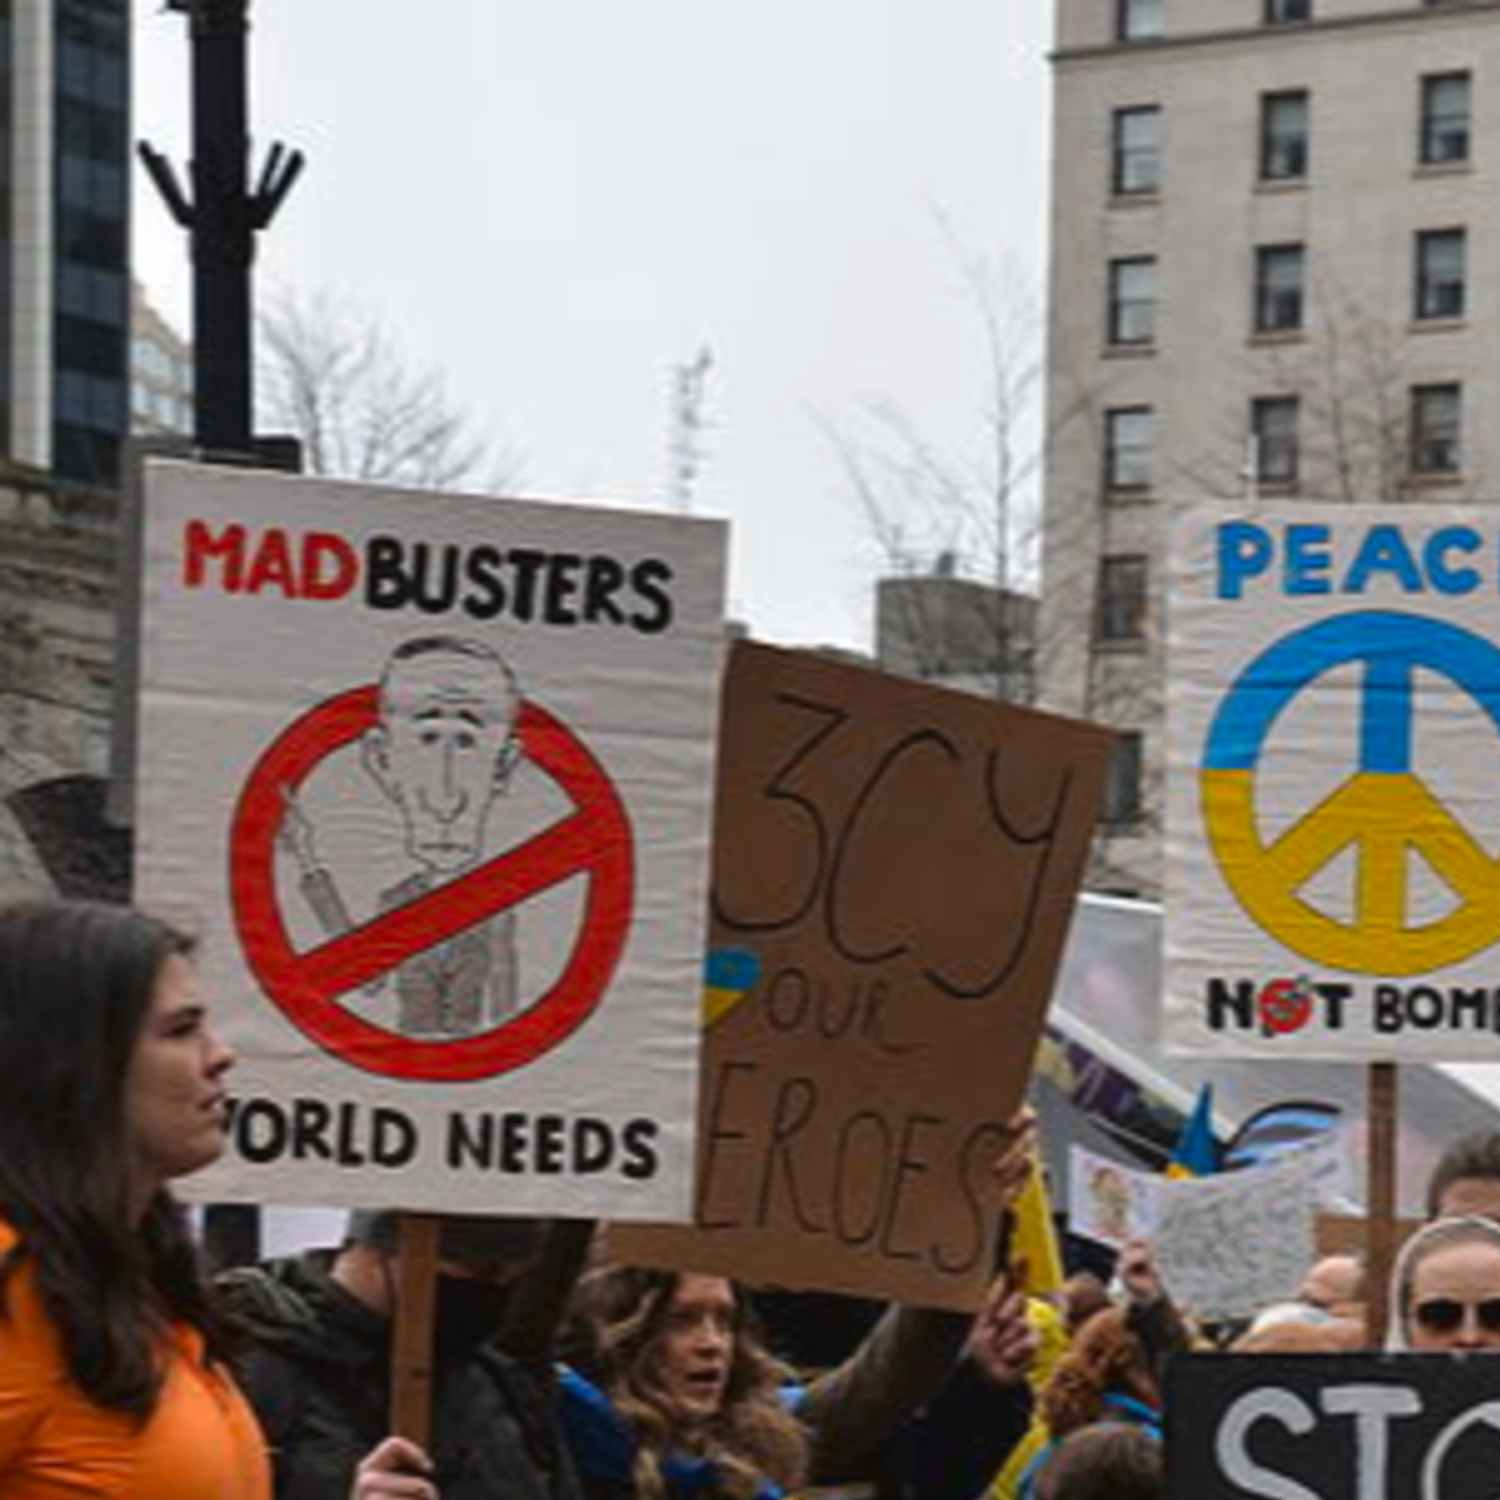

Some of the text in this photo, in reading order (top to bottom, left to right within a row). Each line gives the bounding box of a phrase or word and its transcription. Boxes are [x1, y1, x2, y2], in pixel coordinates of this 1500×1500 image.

[183, 520, 674, 633] MADBUSTERS
[1206, 977, 1352, 1038] NOT
[447, 1112, 658, 1178] NEEDS
[695, 1061, 1014, 1275] EROES
